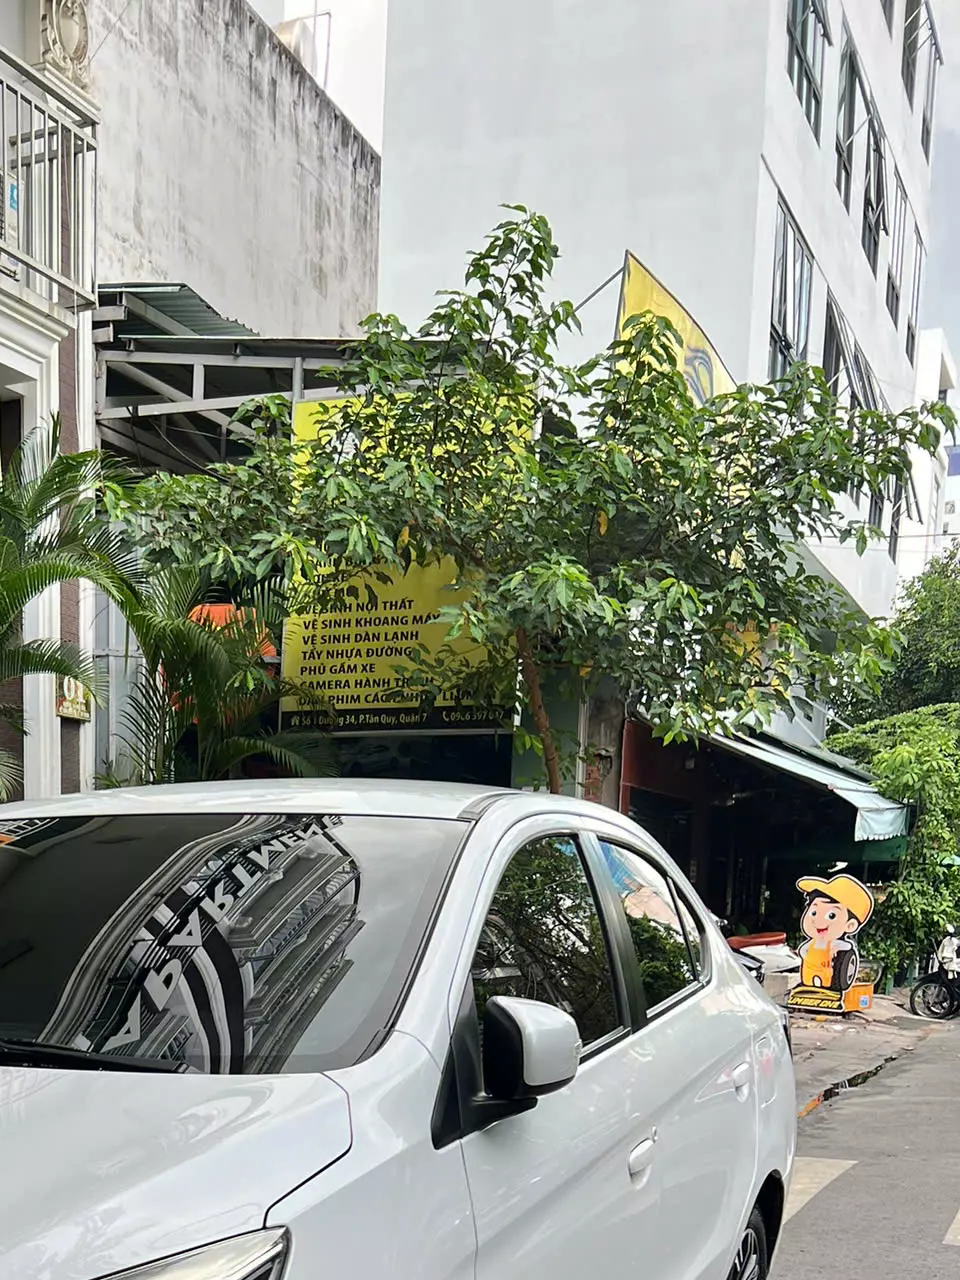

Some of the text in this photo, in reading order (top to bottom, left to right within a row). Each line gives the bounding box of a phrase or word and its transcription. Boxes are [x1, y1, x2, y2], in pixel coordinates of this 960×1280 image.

[382, 597, 414, 610] THẤT
[303, 619, 318, 632] VỆ
[321, 618, 351, 629] SINH
[355, 616, 409, 628] KHOANG
[302, 631, 419, 648] VỆ SINH DÀN LẠNH
[326, 648, 362, 661] NHỰA
[366, 646, 413, 658] ĐƯỜNG
[300, 663, 326, 676] PHỦ
[360, 663, 376, 674] XE
[300, 680, 351, 691] CAMERA
[354, 676, 390, 689] HÀNH
[328, 693, 361, 706] PHIM
[345, 714, 358, 725] 34,
